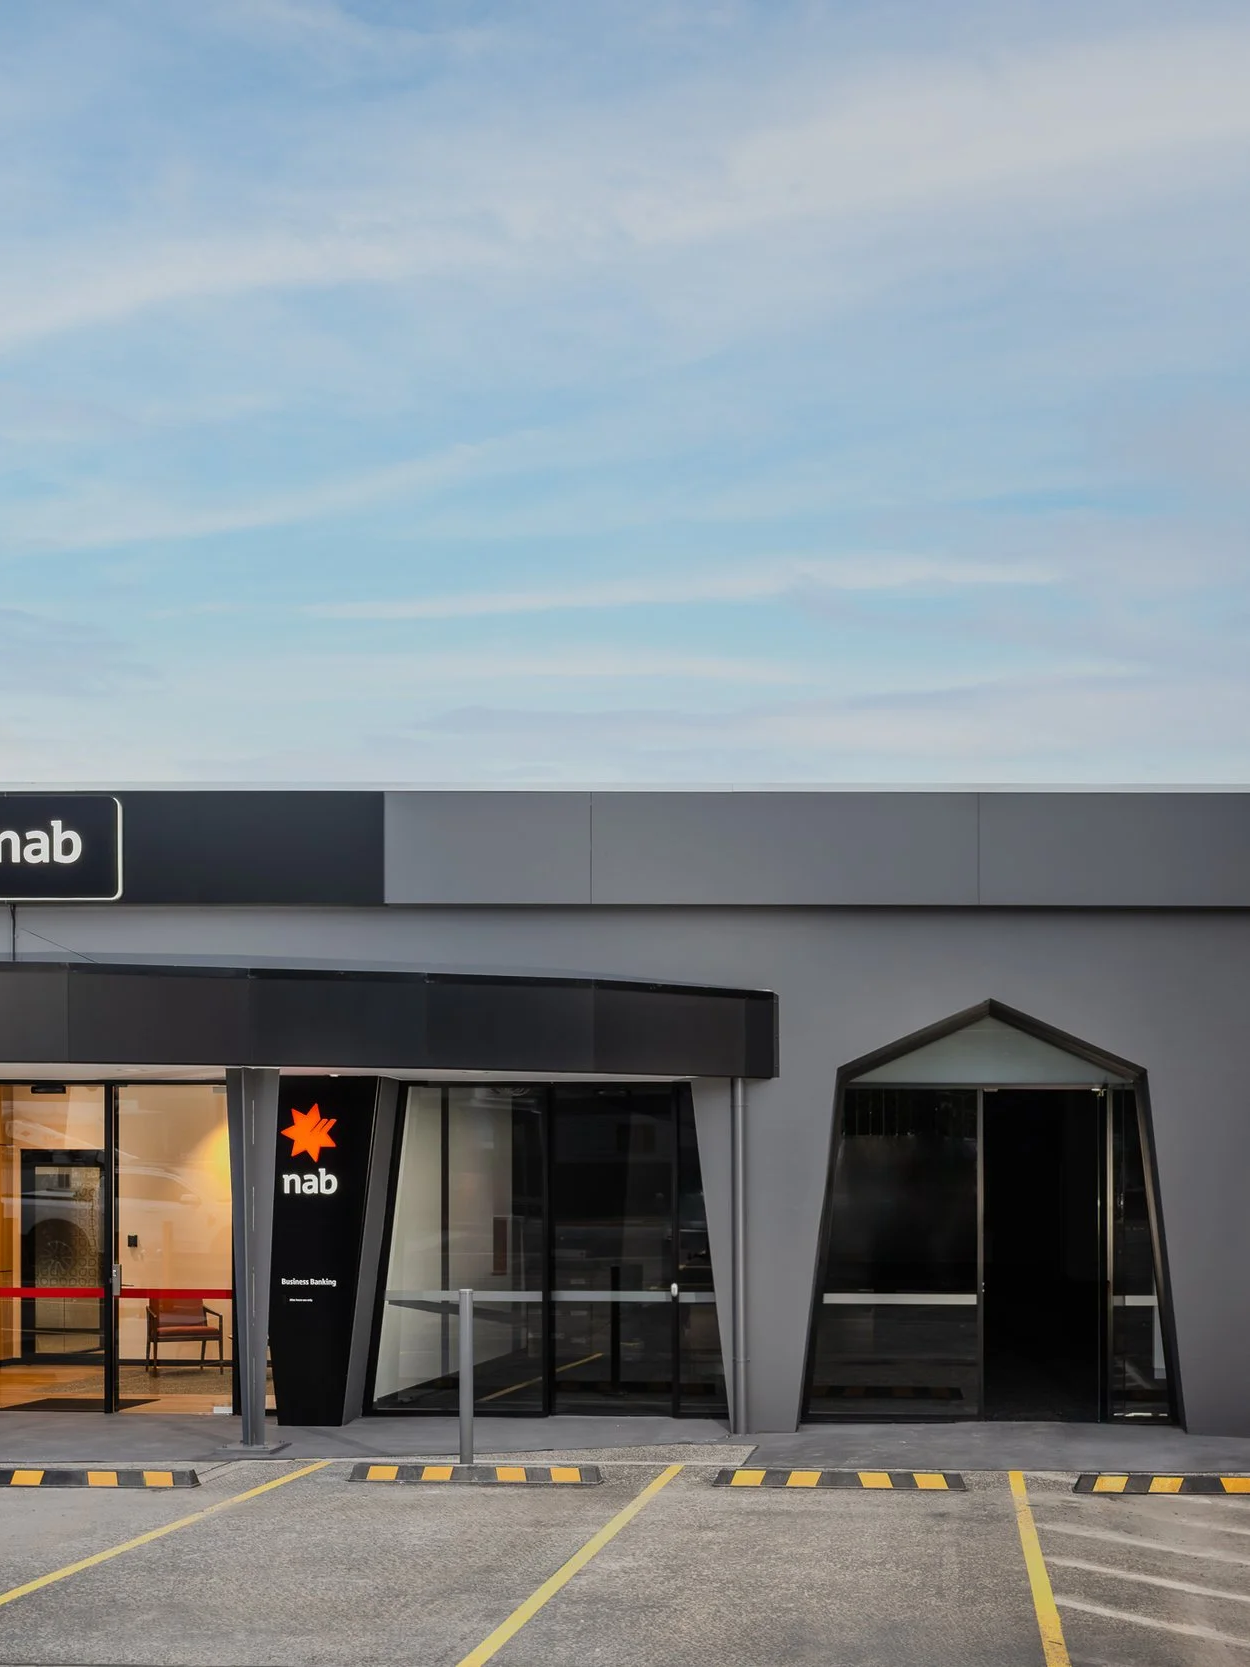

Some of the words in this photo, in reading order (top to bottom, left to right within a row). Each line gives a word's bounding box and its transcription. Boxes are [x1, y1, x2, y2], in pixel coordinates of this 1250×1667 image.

[282, 1167, 338, 1195] nab
[281, 1277, 309, 1286] Business
[310, 1277, 337, 1287] Banking
